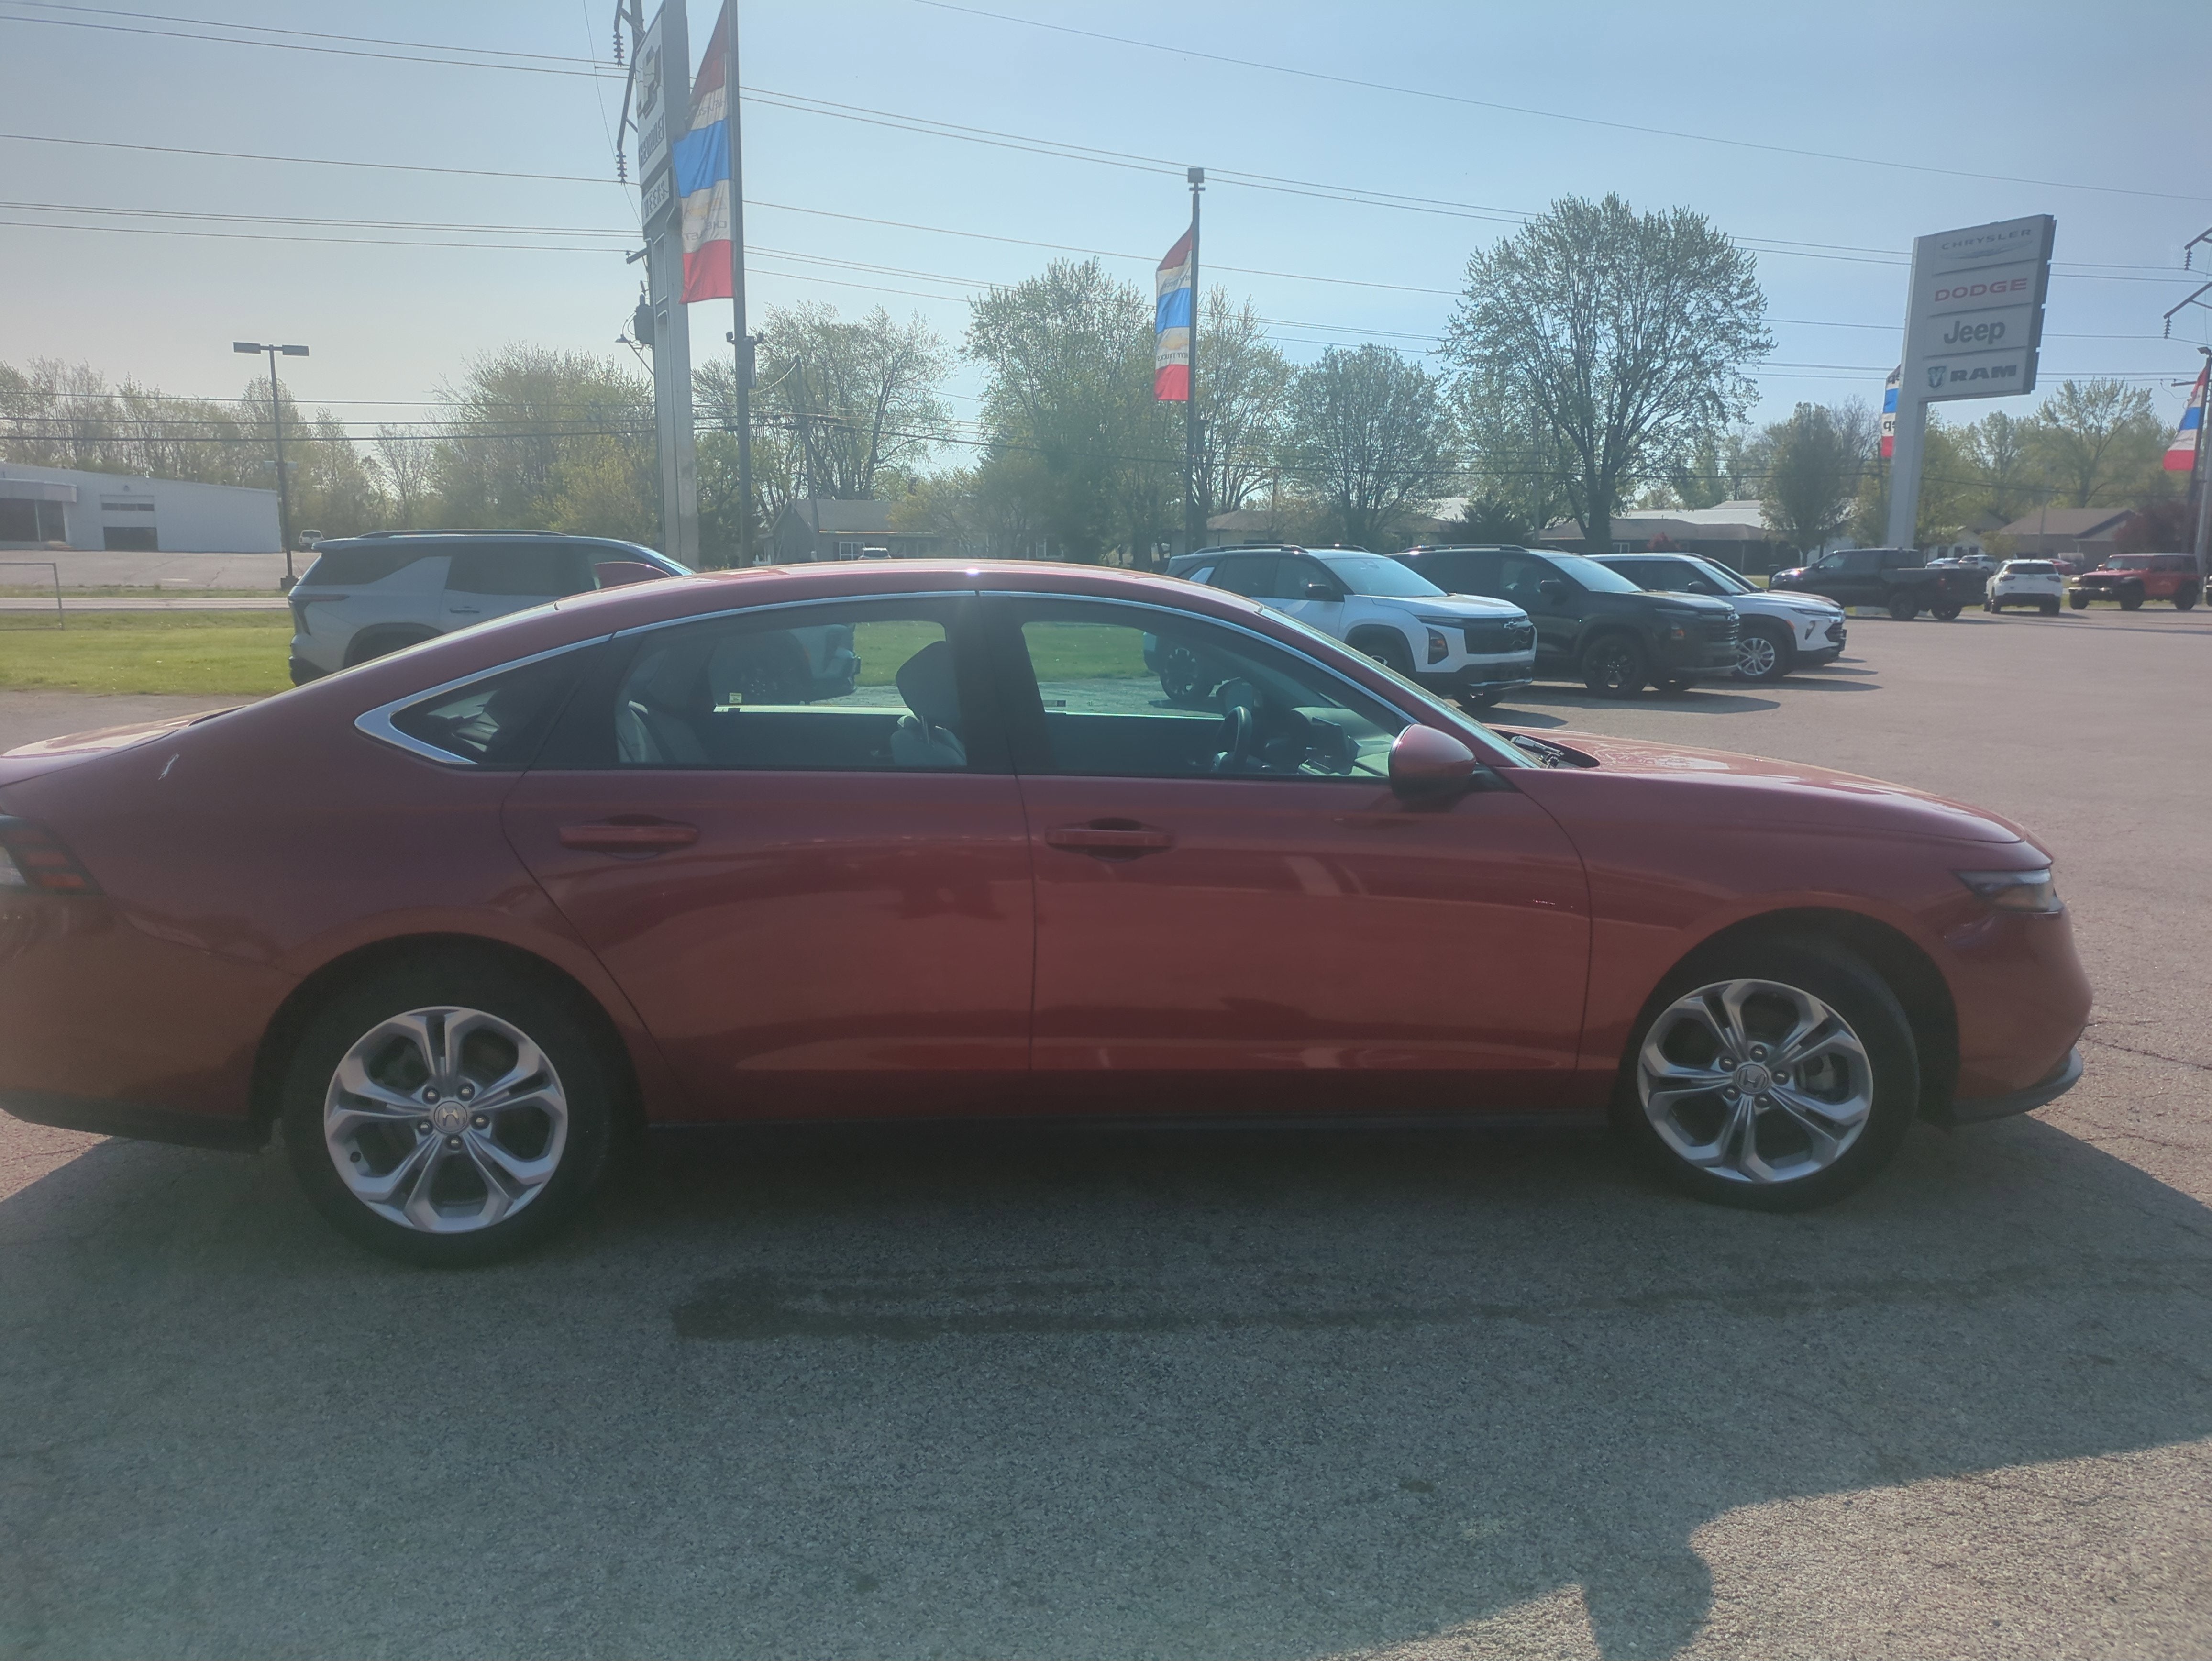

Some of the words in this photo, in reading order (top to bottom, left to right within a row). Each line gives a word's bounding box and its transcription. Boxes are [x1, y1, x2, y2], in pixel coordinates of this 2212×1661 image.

[1941, 229, 2032, 250] CHRYSLER
[1934, 278, 2028, 302] DODGE
[1943, 320, 2006, 345] Jeep
[1950, 365, 2017, 382] RAM
